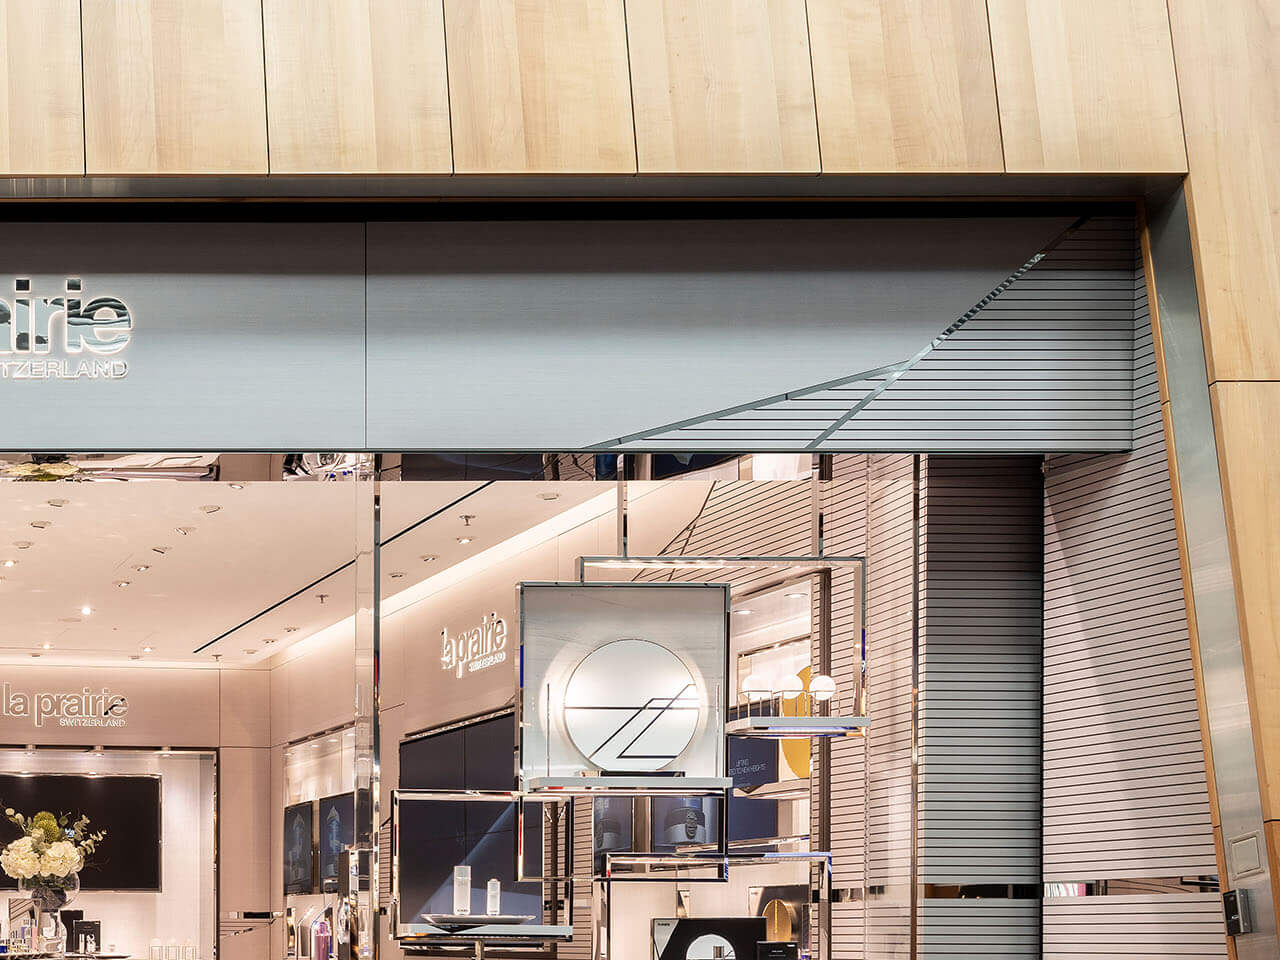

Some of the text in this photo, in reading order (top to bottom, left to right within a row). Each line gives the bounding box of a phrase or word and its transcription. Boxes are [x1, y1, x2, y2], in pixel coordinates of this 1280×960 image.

[456, 611, 507, 678] prairie
[2, 681, 129, 728] la prairie
[59, 718, 126, 727] SWITZERLAND
